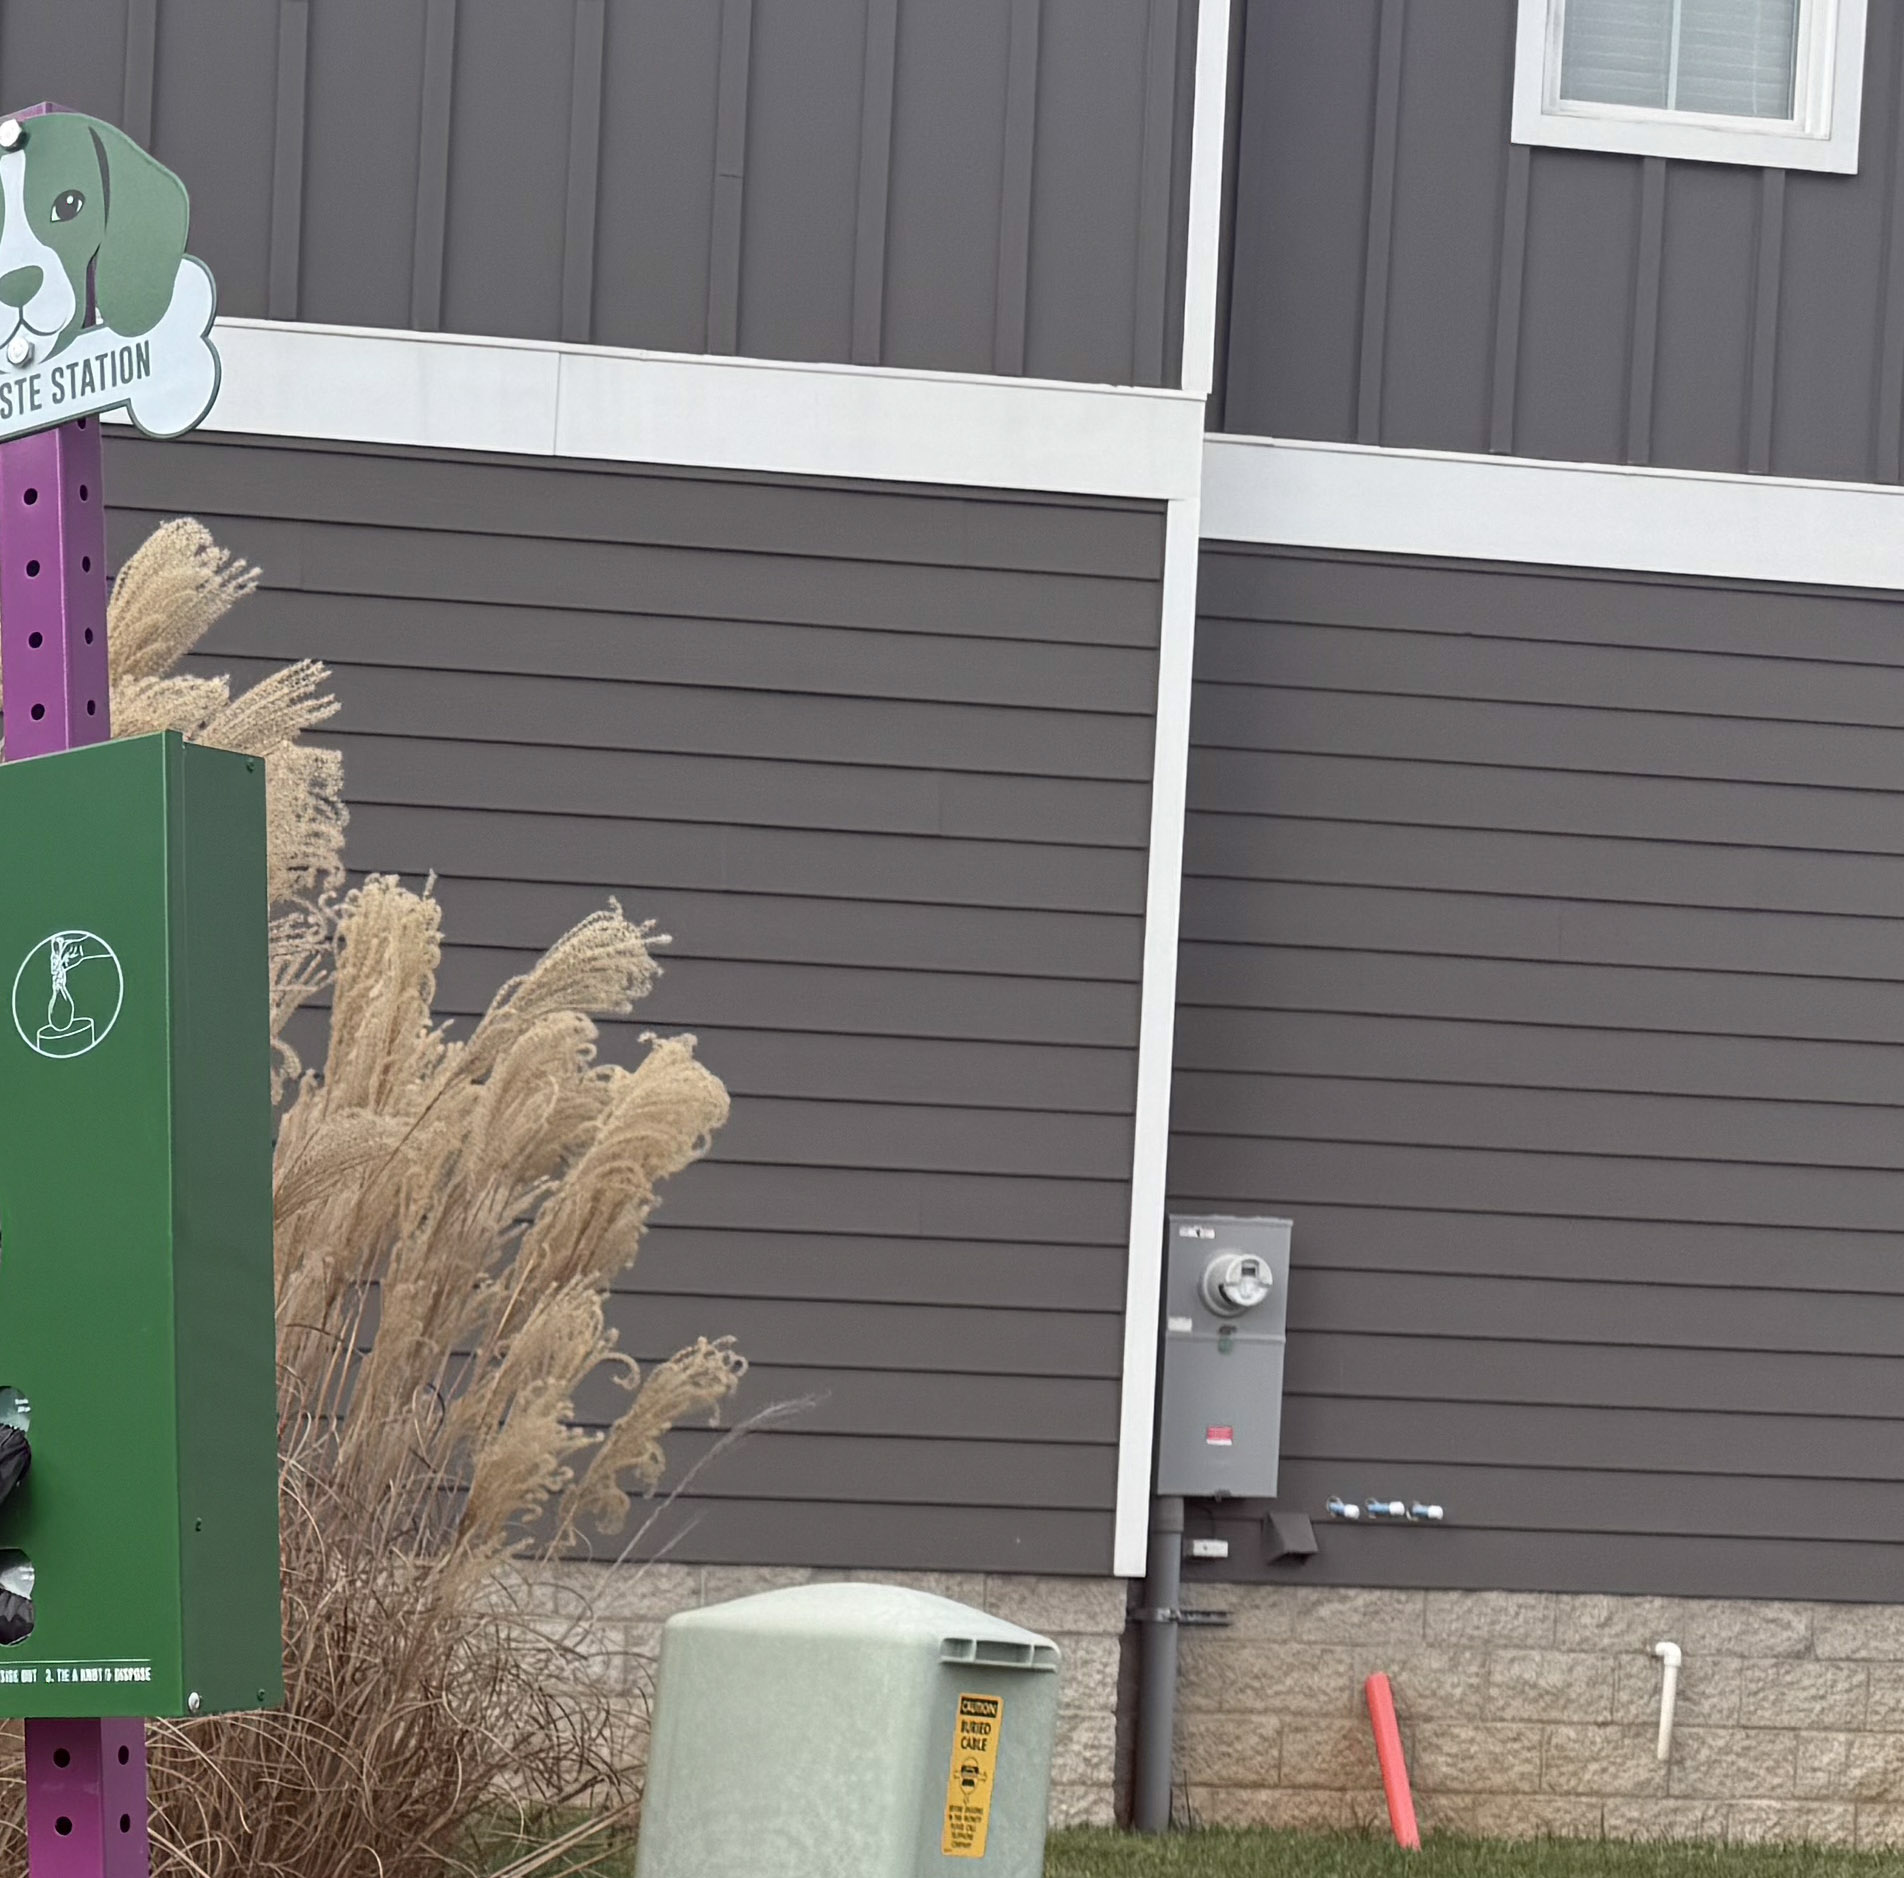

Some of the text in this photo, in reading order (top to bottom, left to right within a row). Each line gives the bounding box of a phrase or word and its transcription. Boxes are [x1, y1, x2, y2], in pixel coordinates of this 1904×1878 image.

[51, 339, 151, 404] STATION
[962, 1700, 997, 1715] CAUTION
[960, 1719, 992, 1736] BURIED
[960, 1736, 988, 1752] CABLE
